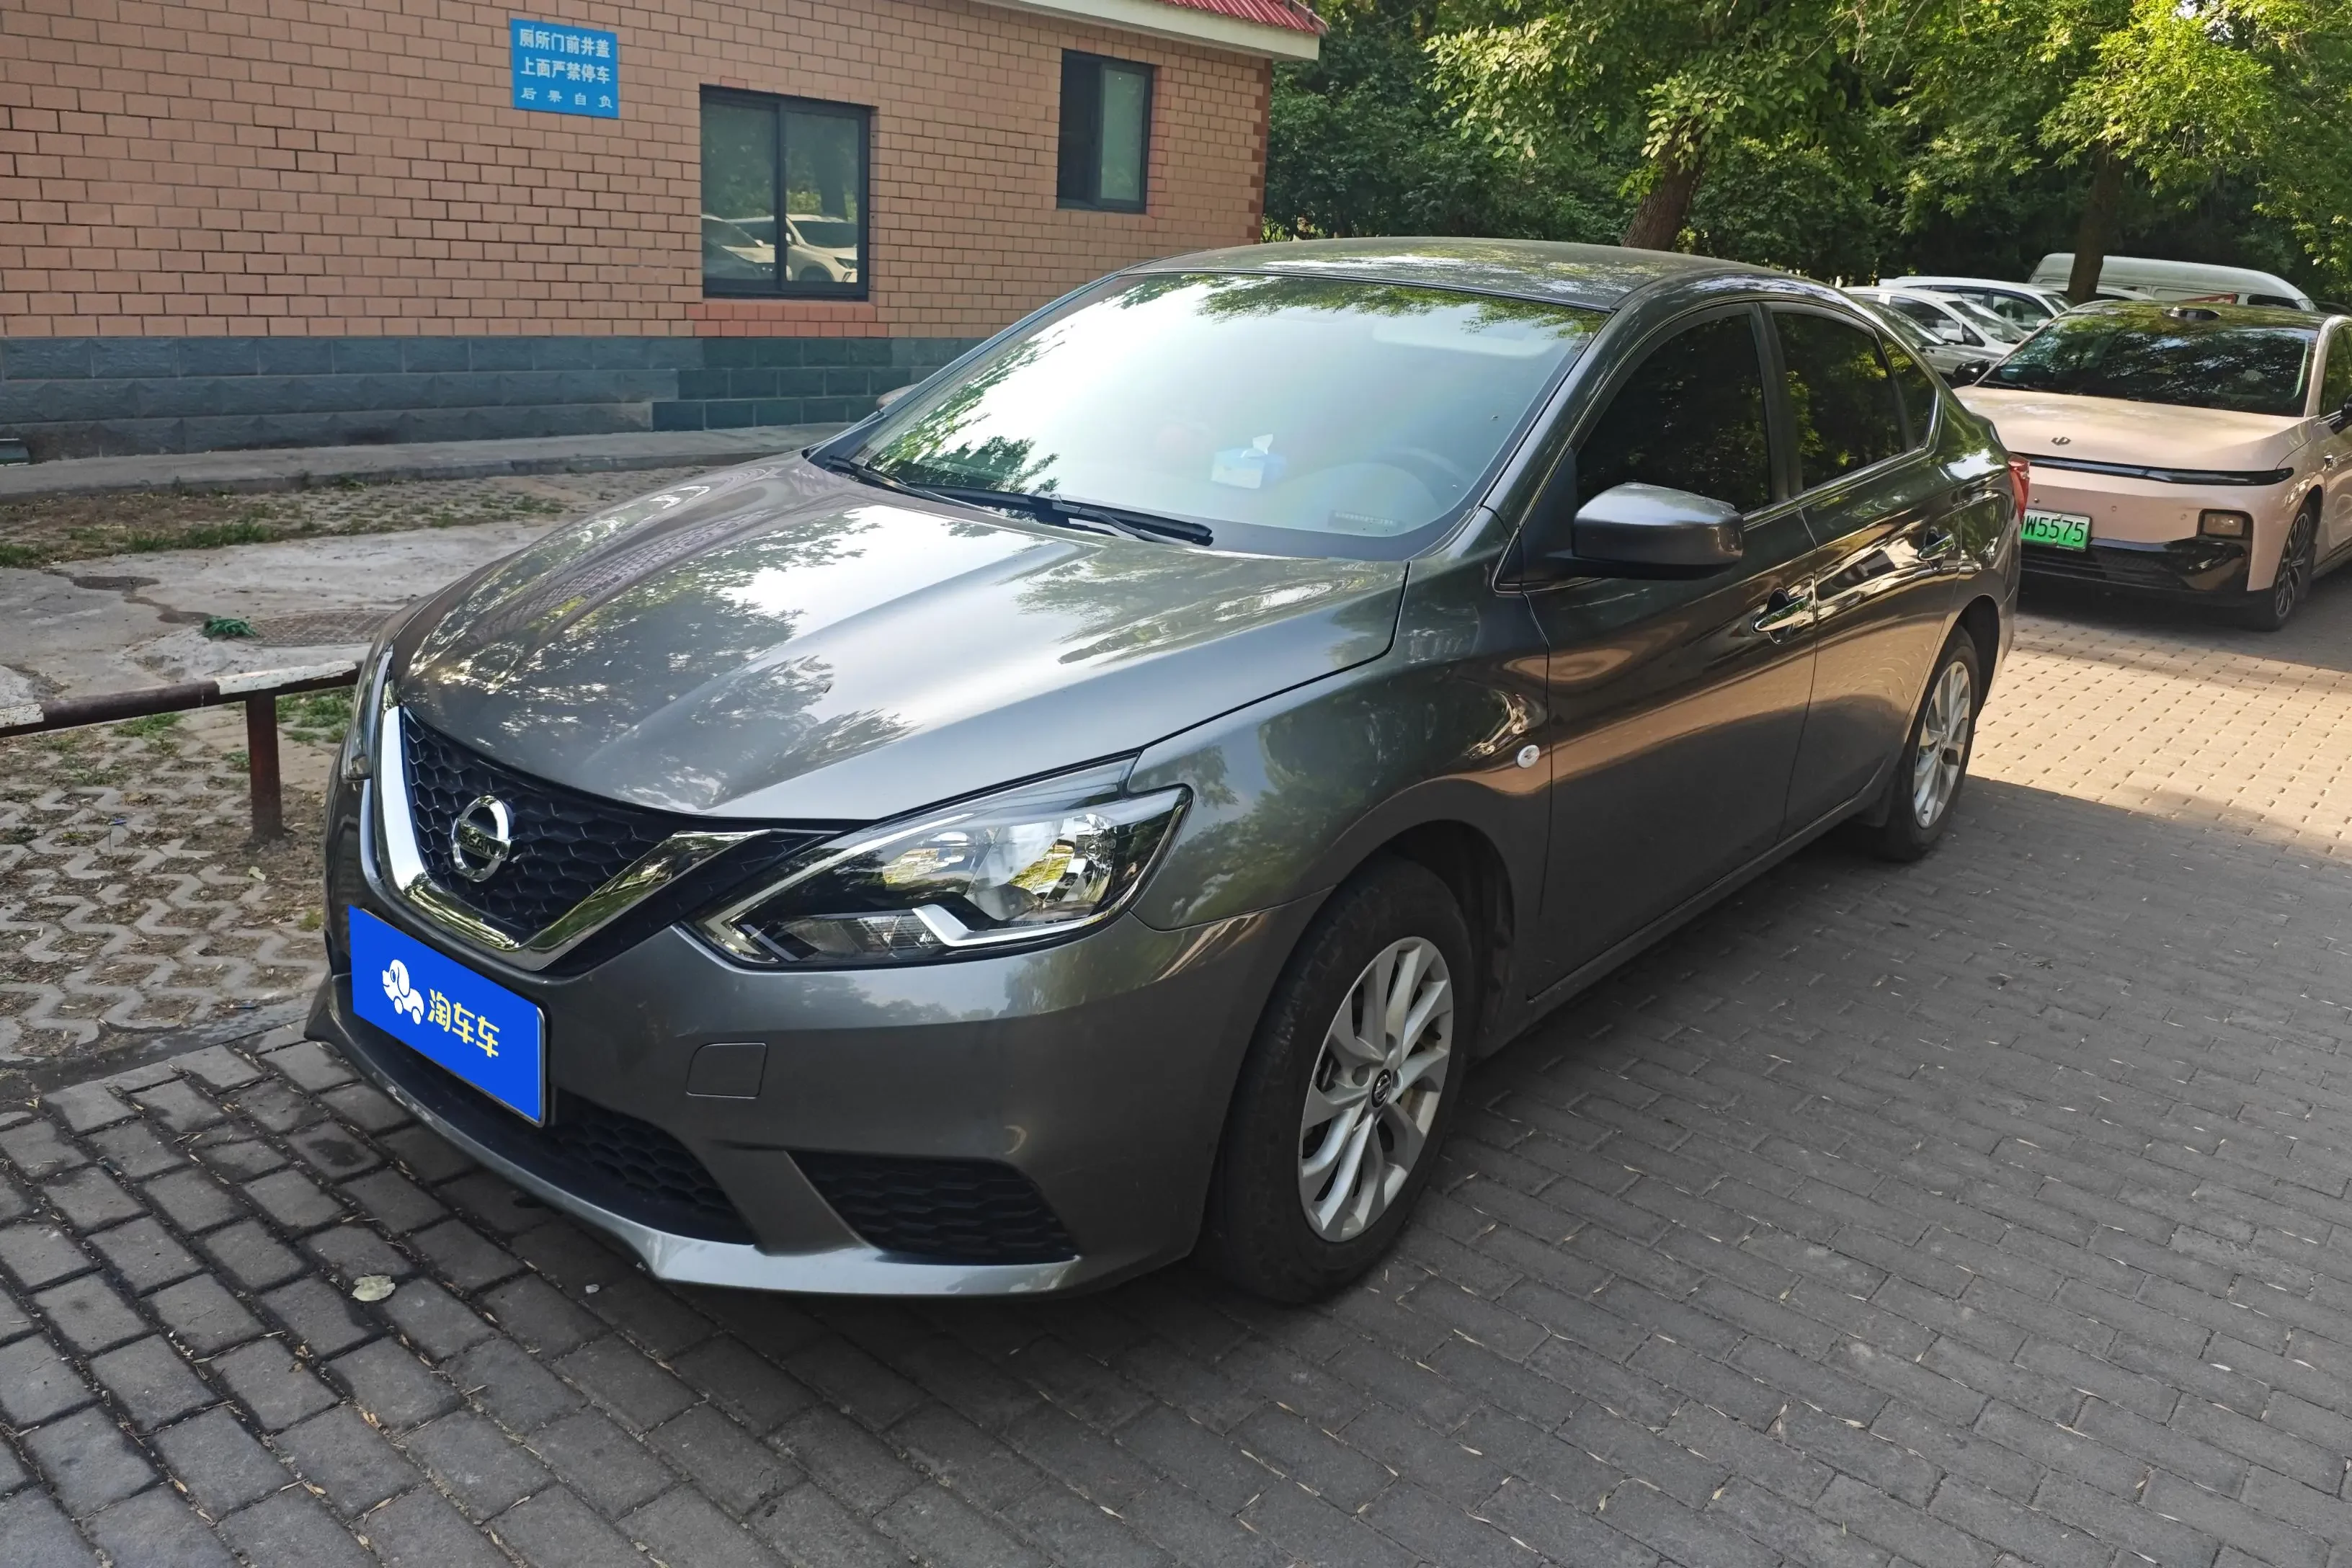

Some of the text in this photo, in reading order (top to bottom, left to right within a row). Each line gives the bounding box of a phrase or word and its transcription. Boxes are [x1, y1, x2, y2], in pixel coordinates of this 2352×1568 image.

[519, 28, 611, 58] 厕所门前井盖
[520, 56, 611, 84] 上面严禁停车
[520, 87, 613, 109] 后果自负
[2021, 514, 2086, 543] W5575
